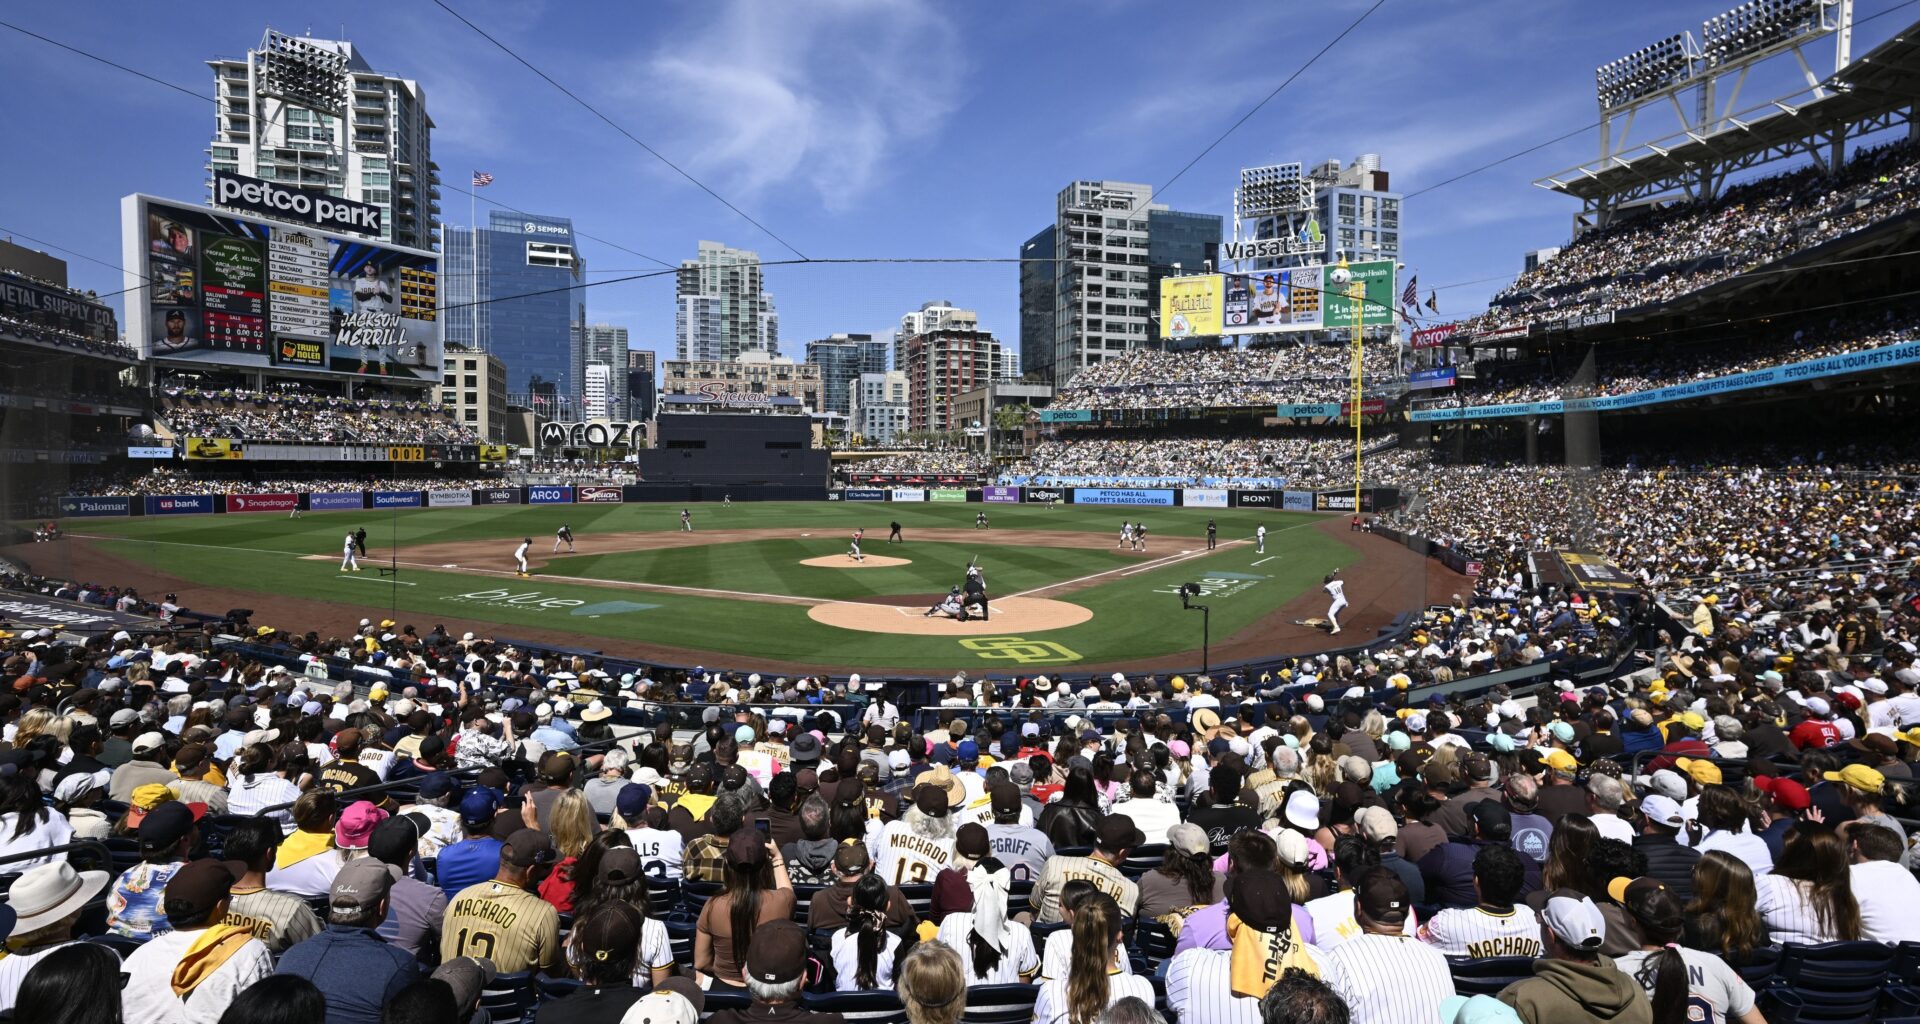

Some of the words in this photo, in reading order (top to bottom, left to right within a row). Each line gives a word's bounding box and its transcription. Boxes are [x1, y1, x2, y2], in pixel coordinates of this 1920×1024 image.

[220, 177, 311, 213] petco
[316, 198, 378, 229] park
[537, 225, 569, 234] SEMPRA
[286, 235, 313, 248] PADRES
[1224, 238, 1291, 259] Viasat
[278, 265, 302, 273] MACHADO
[43, 295, 90, 321] SUPPLY
[94, 308, 113, 327] CO.
[280, 306, 310, 314] CRONENWORTH
[1330, 304, 1340, 314] #1
[1365, 304, 1387, 313] Diego
[280, 316, 306, 324] LOCKRIDGE
[340, 313, 400, 327] JACKSON
[336, 328, 407, 346] MERRILL
[1415, 329, 1451, 346] xerox
[297, 343, 320, 351] TRULY
[408, 346, 416, 357] 3
[297, 350, 320, 360] NOLEN
[1785, 366, 1808, 378] PETCO
[1810, 363, 1826, 374] HAS
[1827, 361, 1841, 370] ALL
[1842, 356, 1867, 368] YOUR
[1868, 351, 1892, 364] PET'S
[1696, 384, 1710, 392] YOUR
[1710, 381, 1724, 390] PET'S
[1726, 378, 1743, 388] BASES
[1744, 372, 1774, 384] COVERED
[698, 382, 770, 408] Sycuan
[1592, 400, 1611, 408] YOUR
[1294, 405, 1324, 416] petco
[1502, 406, 1530, 414] COVERED
[1053, 412, 1078, 420] petco
[569, 422, 647, 447] razr
[392, 449, 398, 460] 0
[404, 449, 410, 460] 0
[416, 449, 420, 460] 2
[490, 491, 510, 499] stelo
[530, 490, 560, 500] ARCO
[581, 488, 618, 501] Sycuan
[1284, 496, 1302, 504] petco
[80, 502, 126, 511] Palomar
[174, 500, 200, 508] bank
[248, 498, 294, 508] Snapdragon
[458, 588, 585, 607] blue
[360, 752, 384, 761] HADO
[322, 768, 358, 786] MACHADO
[890, 834, 948, 864] MACHADO
[895, 857, 928, 885] 13
[336, 884, 359, 893] Padres
[454, 899, 516, 929] MACHADO
[456, 927, 496, 960] 13
[1467, 937, 1540, 958] MACHADO
